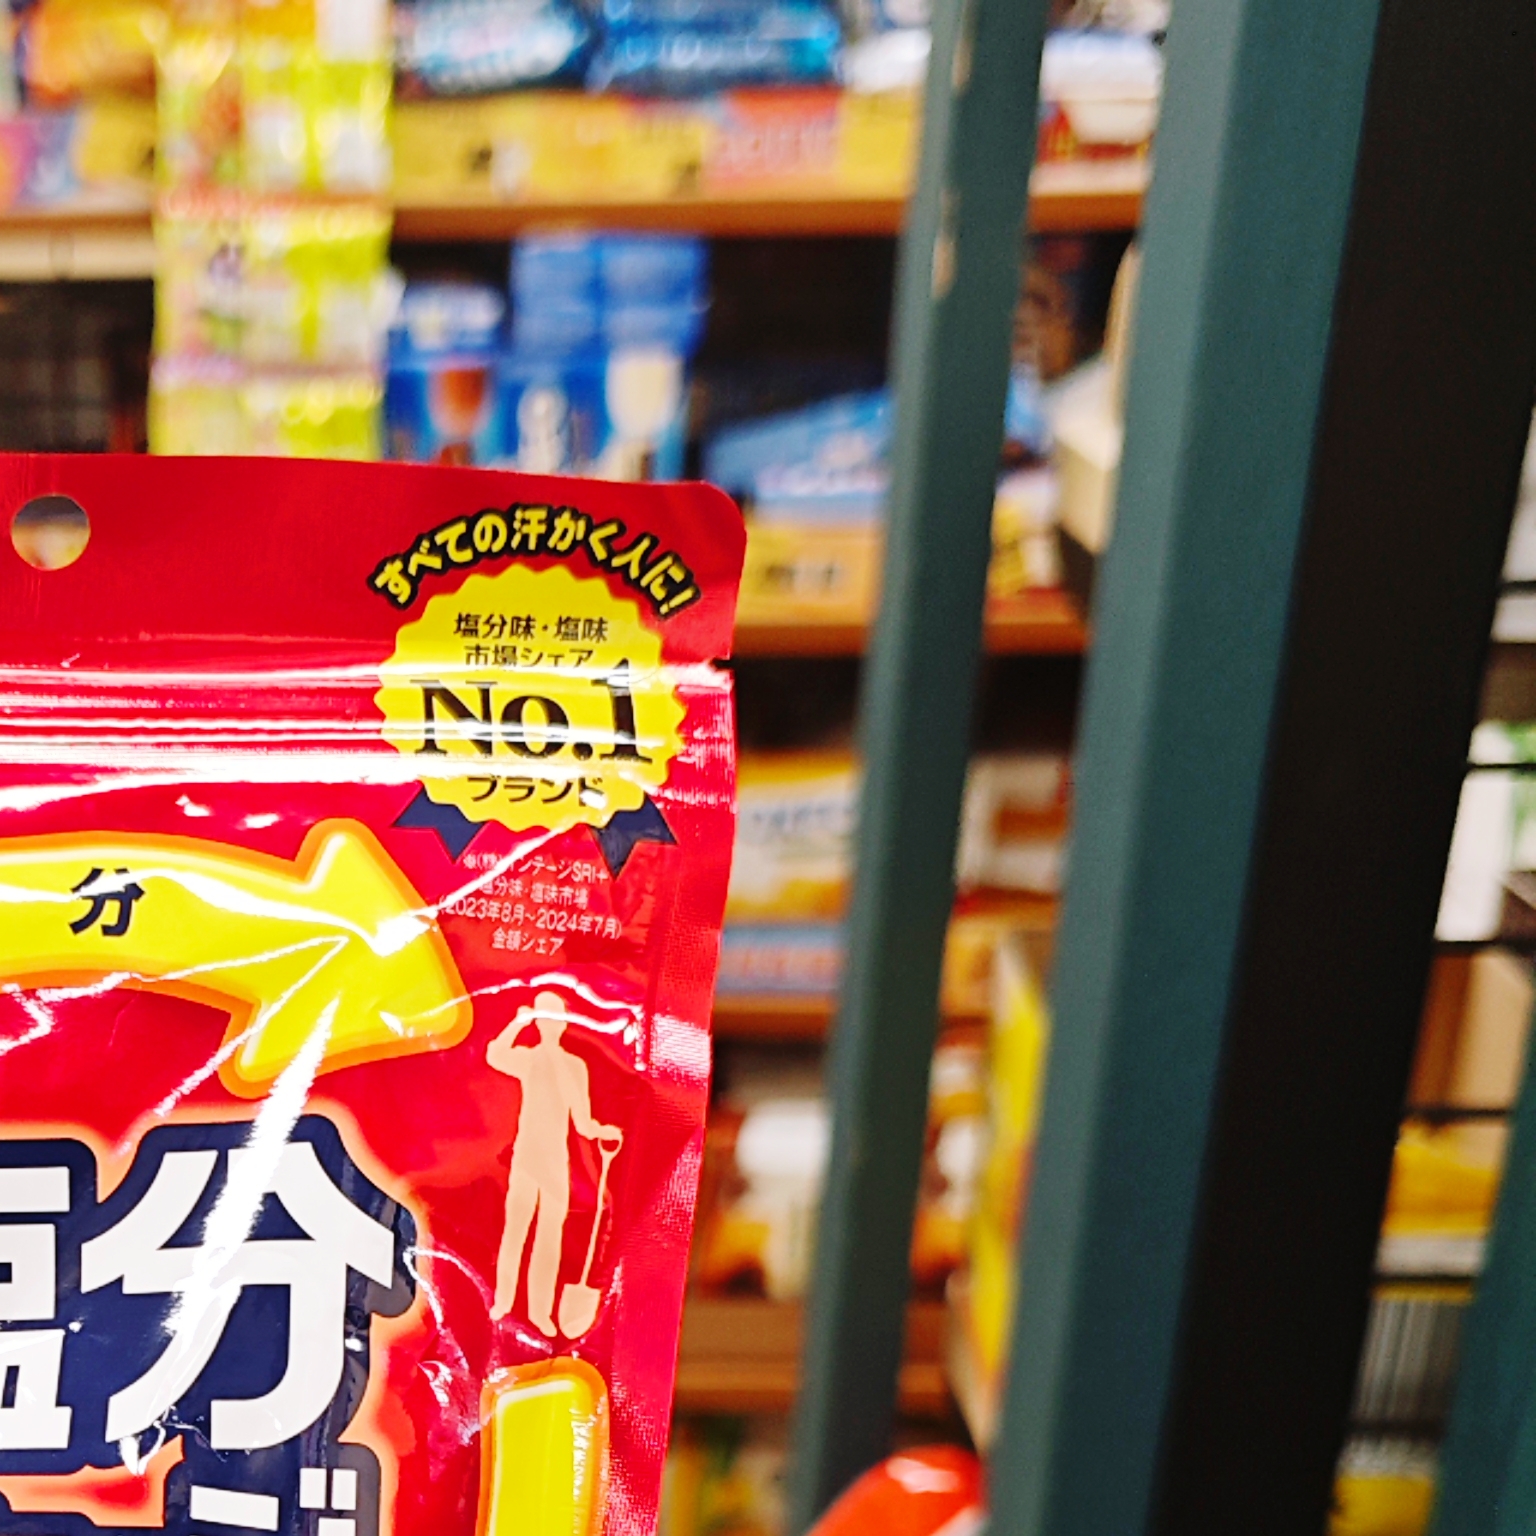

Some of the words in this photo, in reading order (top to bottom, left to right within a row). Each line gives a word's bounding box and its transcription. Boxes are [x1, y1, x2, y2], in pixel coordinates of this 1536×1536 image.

[372, 505, 696, 616] すべての汗かく人に!
[453, 612, 609, 643] 塩分味・塩味
[464, 644, 594, 669] 市場シェア
[410, 658, 654, 765] No.1
[467, 776, 605, 806] ブランド
